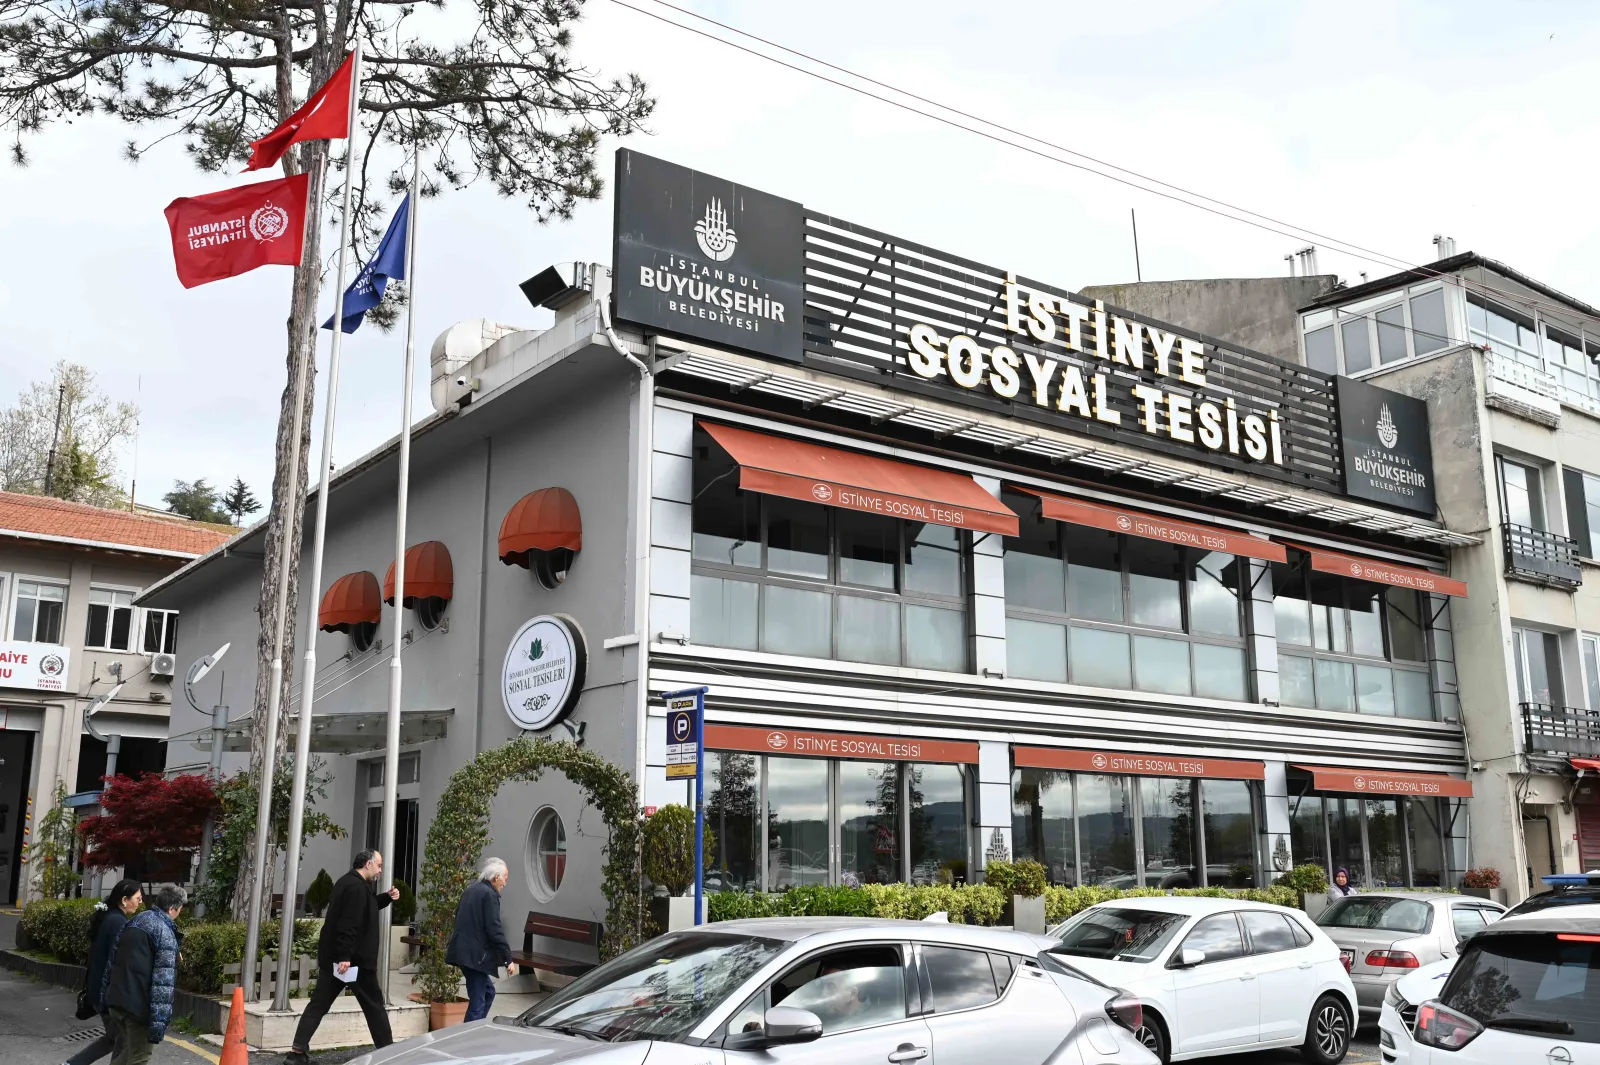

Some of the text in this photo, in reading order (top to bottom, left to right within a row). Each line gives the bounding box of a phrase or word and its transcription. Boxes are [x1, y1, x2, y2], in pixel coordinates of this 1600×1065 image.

[669, 254, 759, 290] İSTANBUL
[640, 265, 785, 323] BÜYÜKŞEHİR
[669, 300, 759, 332] BELEDİYESİ
[1003, 271, 1206, 387] İSTİNYE
[907, 323, 1284, 465] SOSYAL TESİSİ
[1354, 455, 1426, 487] BÜYÜKŞEHİR
[1366, 447, 1411, 467] İSTANBUL
[1369, 479, 1415, 496] BELEDİYESİ
[838, 489, 964, 524] İSTİNYE SOSYAL TESİSİ
[1135, 520, 1227, 549] İSTİNYE SOSYAL TESİSİ
[1364, 567, 1435, 589] İSTİNYE SOSYAL TESİSİ
[508, 666, 565, 694] SOSYAL TESİSLERİ
[677, 719, 688, 735] P
[793, 735, 921, 757] İSTİNYE SOSYAL TESİSİ
[1110, 756, 1204, 774] İSTİNYE SOSYAL TESİSİ
[1368, 778, 1440, 793] İSTİNYE SOSYAL TESİSİ
